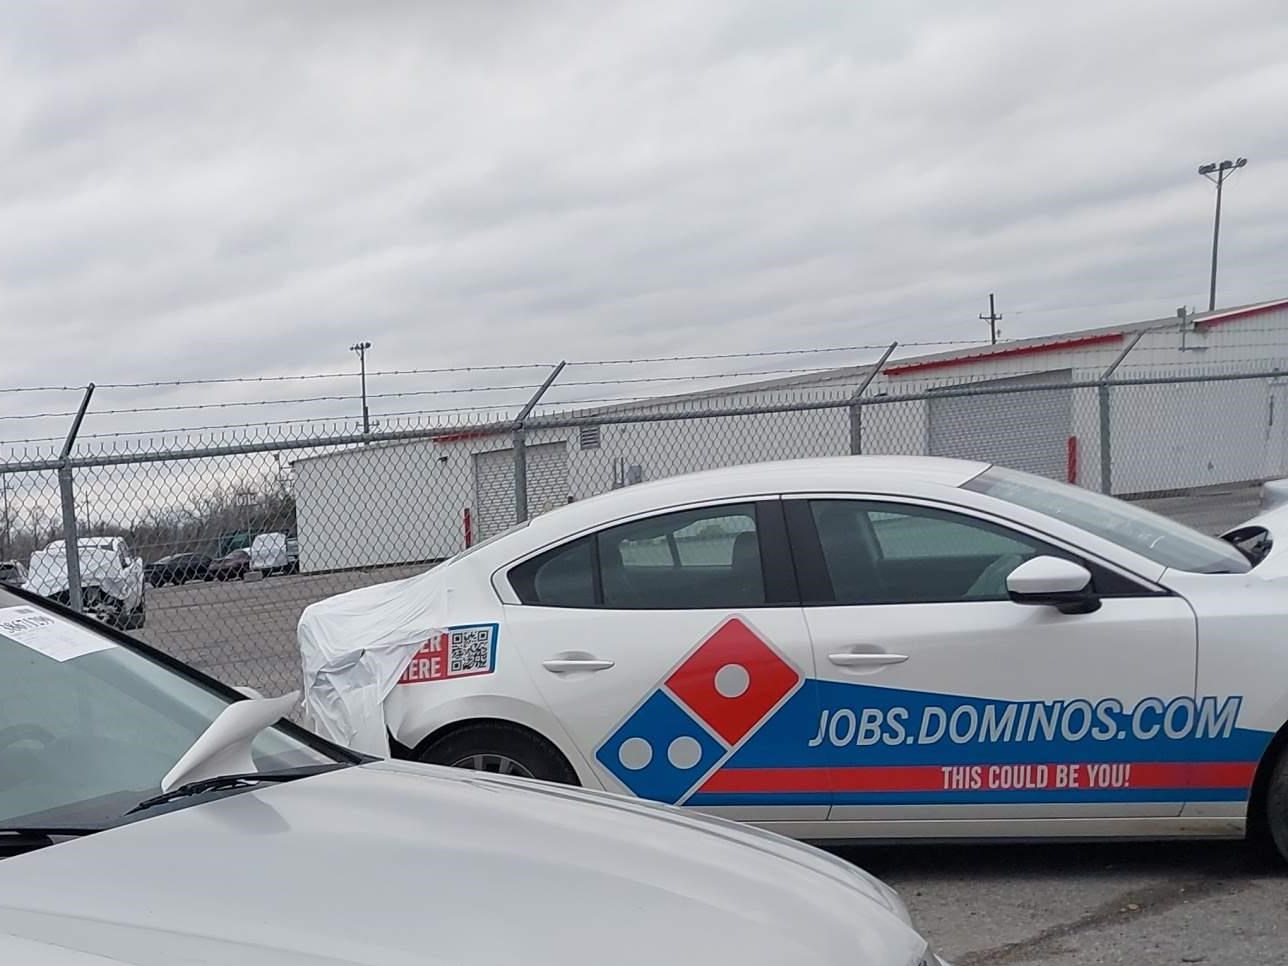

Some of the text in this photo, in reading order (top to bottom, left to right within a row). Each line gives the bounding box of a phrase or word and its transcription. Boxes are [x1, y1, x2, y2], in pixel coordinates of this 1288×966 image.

[807, 697, 1243, 747] JOBS.DOMINOS.COM
[941, 763, 1131, 790] THIS COULD BE YOU!
